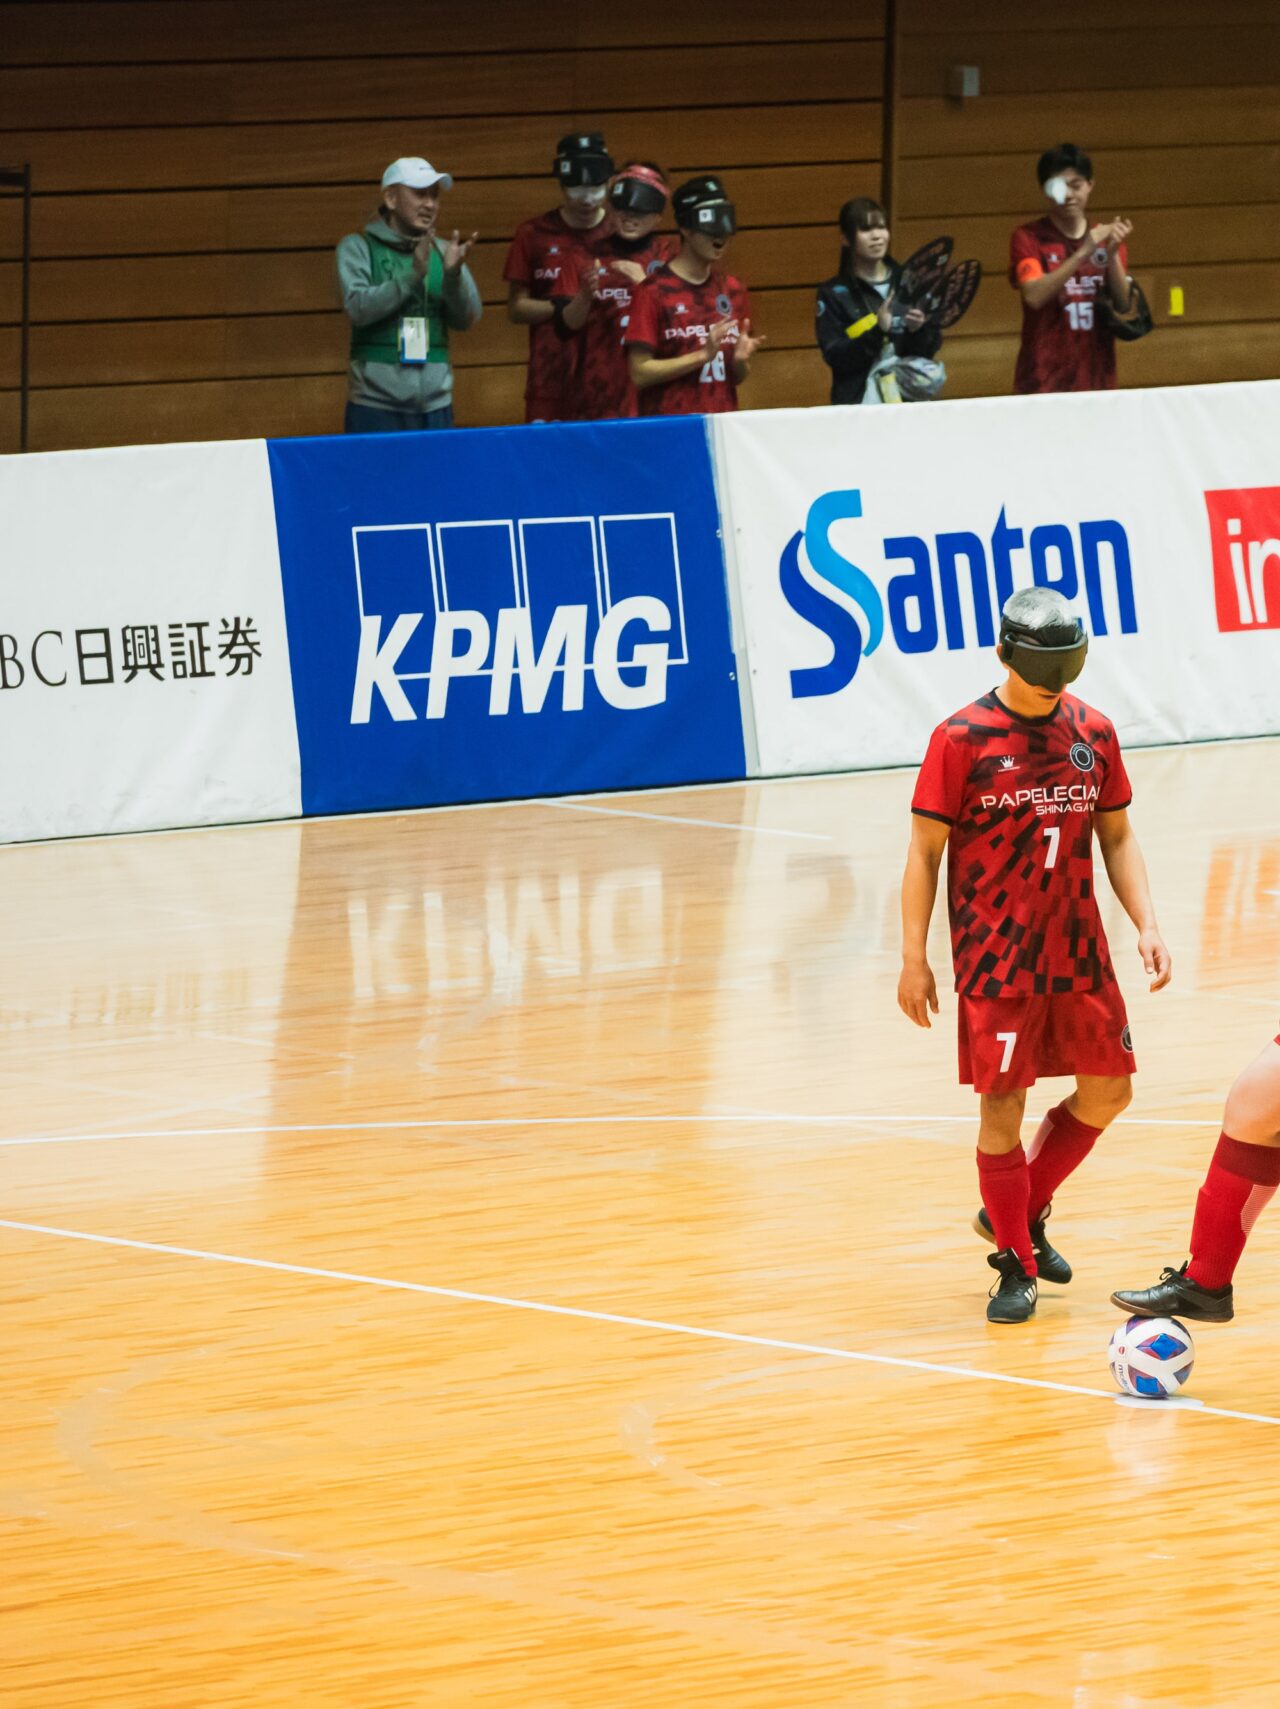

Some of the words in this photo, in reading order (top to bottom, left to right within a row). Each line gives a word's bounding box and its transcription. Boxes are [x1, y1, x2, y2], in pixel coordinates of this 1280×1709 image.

[1064, 302, 1094, 331] 15
[699, 350, 726, 383] 26
[779, 489, 1138, 699] Santen
[350, 595, 672, 725] KPMG
[1043, 826, 1060, 869] 7
[996, 1031, 1018, 1073] 7
